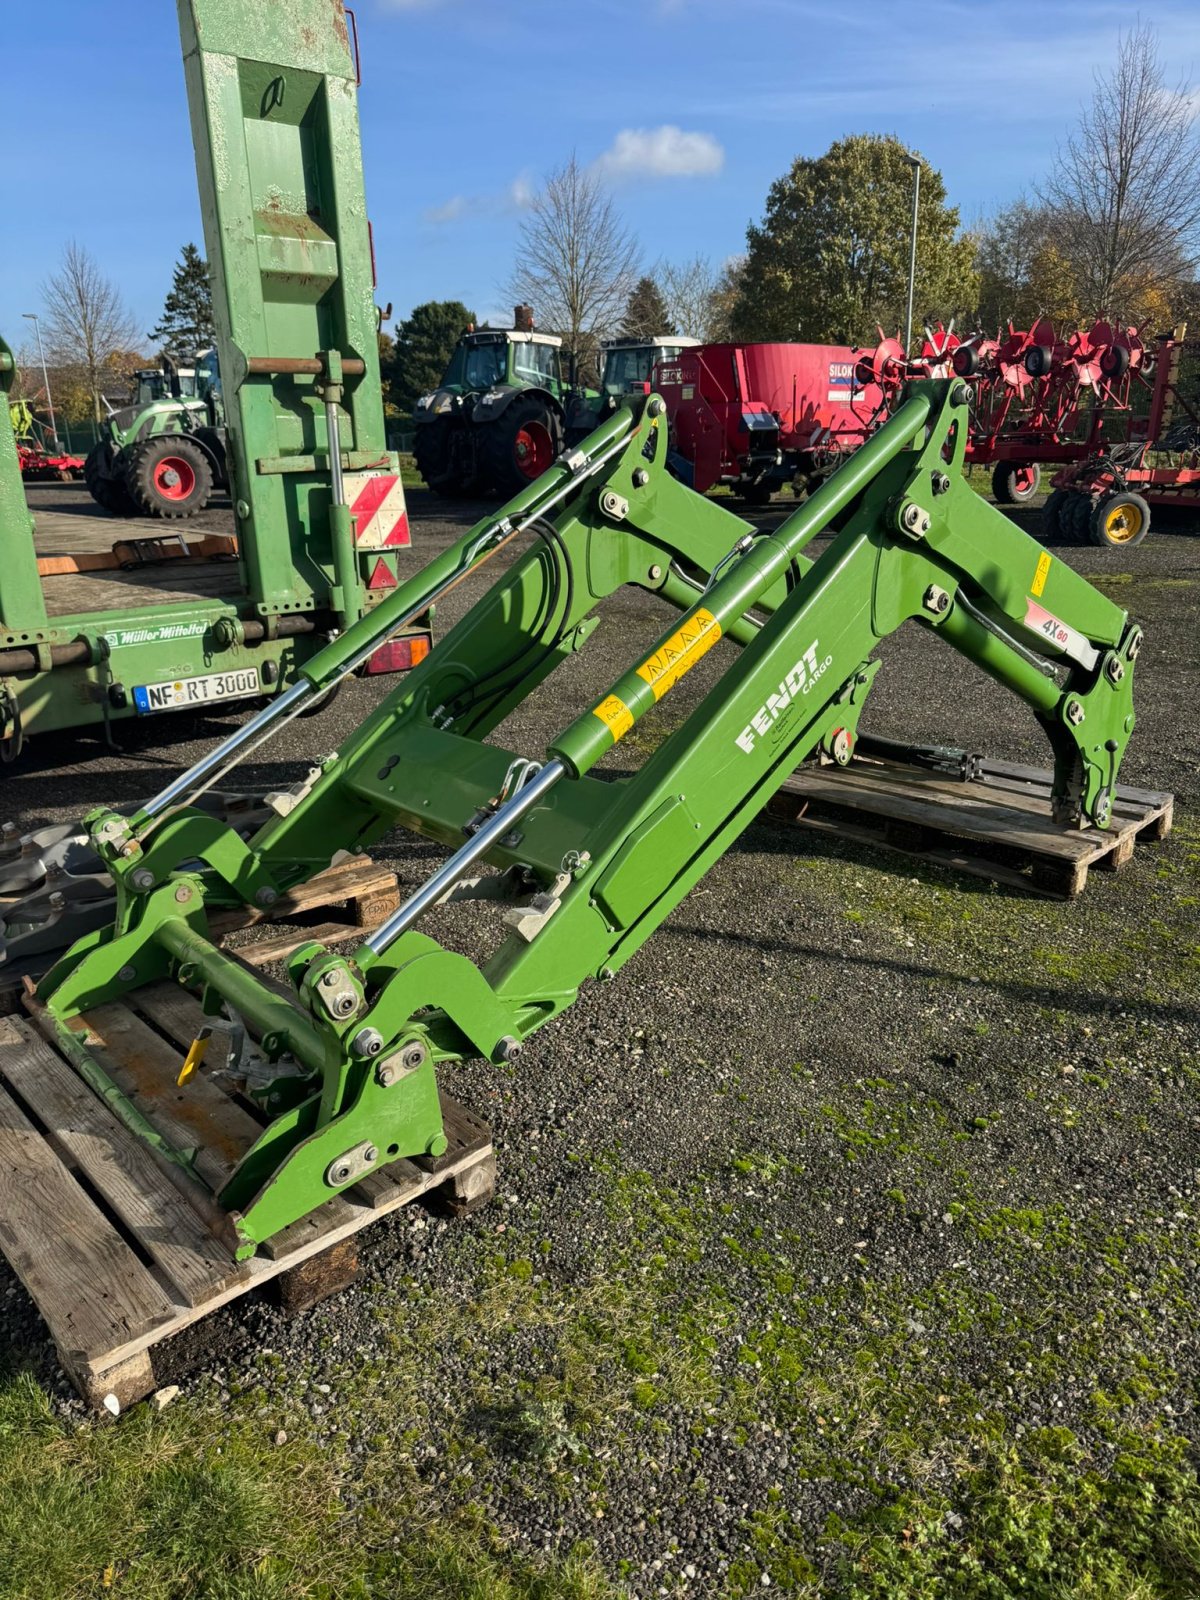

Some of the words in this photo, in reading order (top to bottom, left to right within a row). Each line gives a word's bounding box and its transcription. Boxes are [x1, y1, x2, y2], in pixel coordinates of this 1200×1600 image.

[121, 629, 159, 644] Müller
[159, 621, 208, 639] Mitteltal
[149, 685, 172, 707] NF
[187, 679, 209, 700] RT
[214, 671, 257, 695] 3000
[802, 655, 833, 694] CARGO
[734, 639, 819, 754] FENDT
